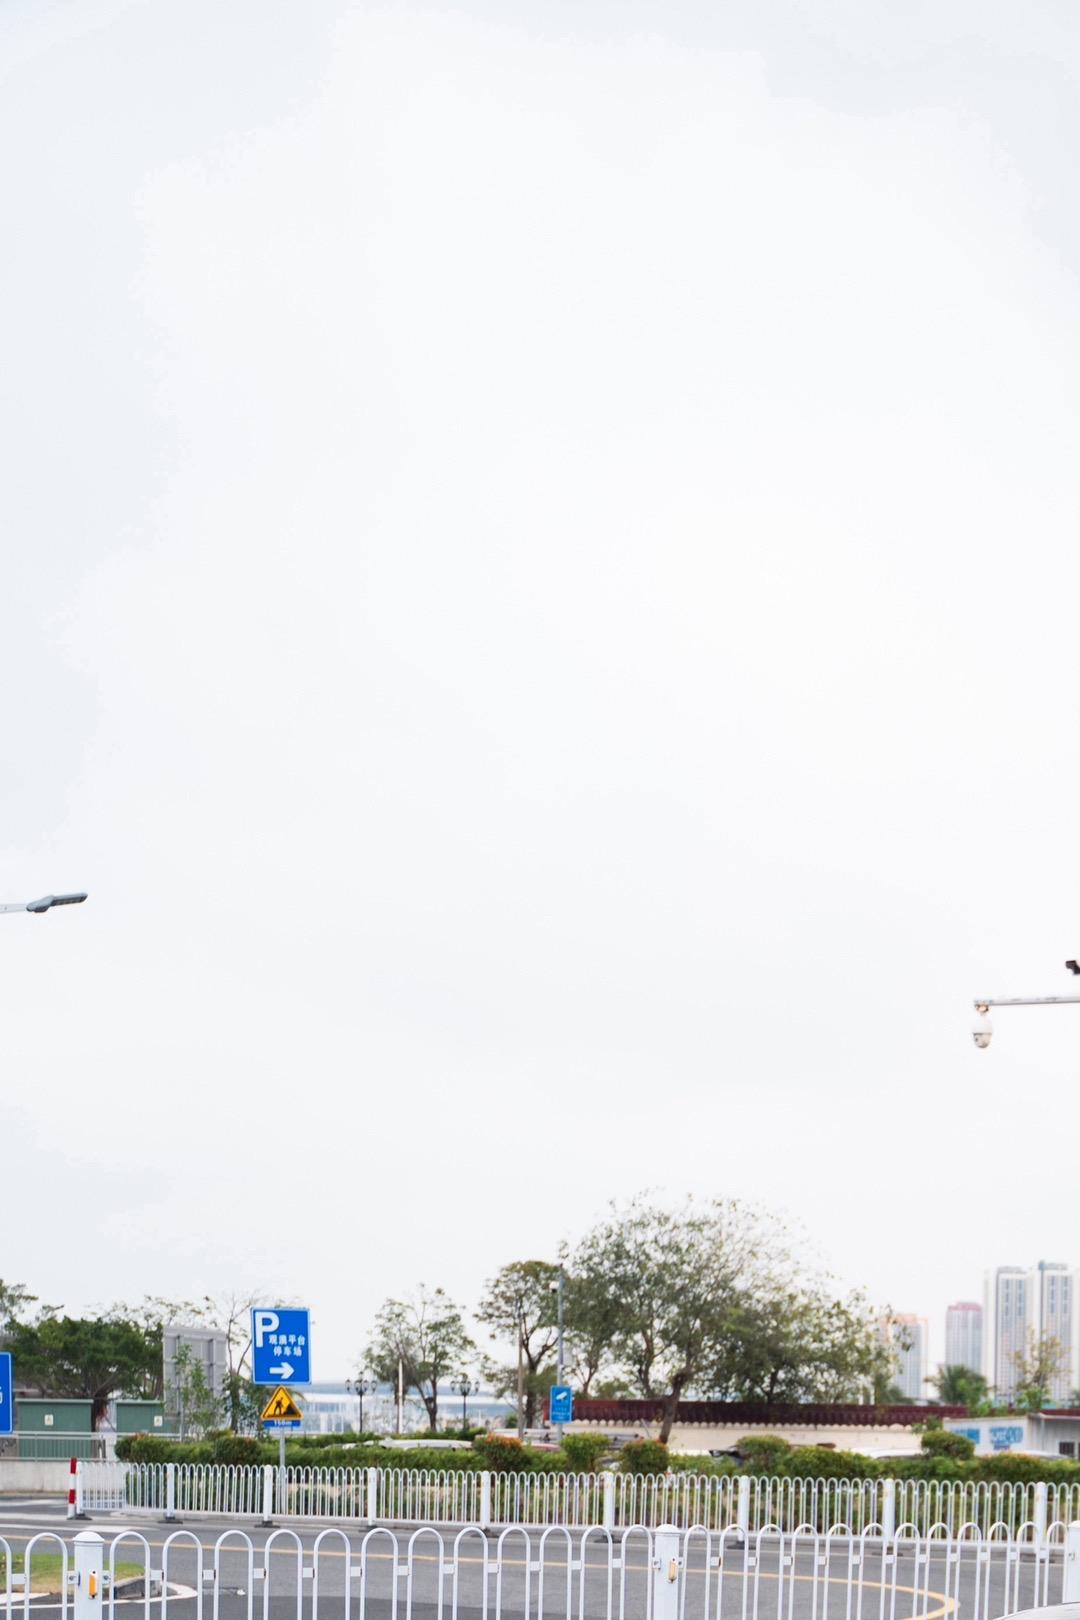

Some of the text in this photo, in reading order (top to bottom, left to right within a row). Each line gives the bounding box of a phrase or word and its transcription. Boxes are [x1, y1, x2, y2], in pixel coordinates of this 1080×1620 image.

[255, 1311, 280, 1348] P
[273, 1345, 303, 1357] 停车场
